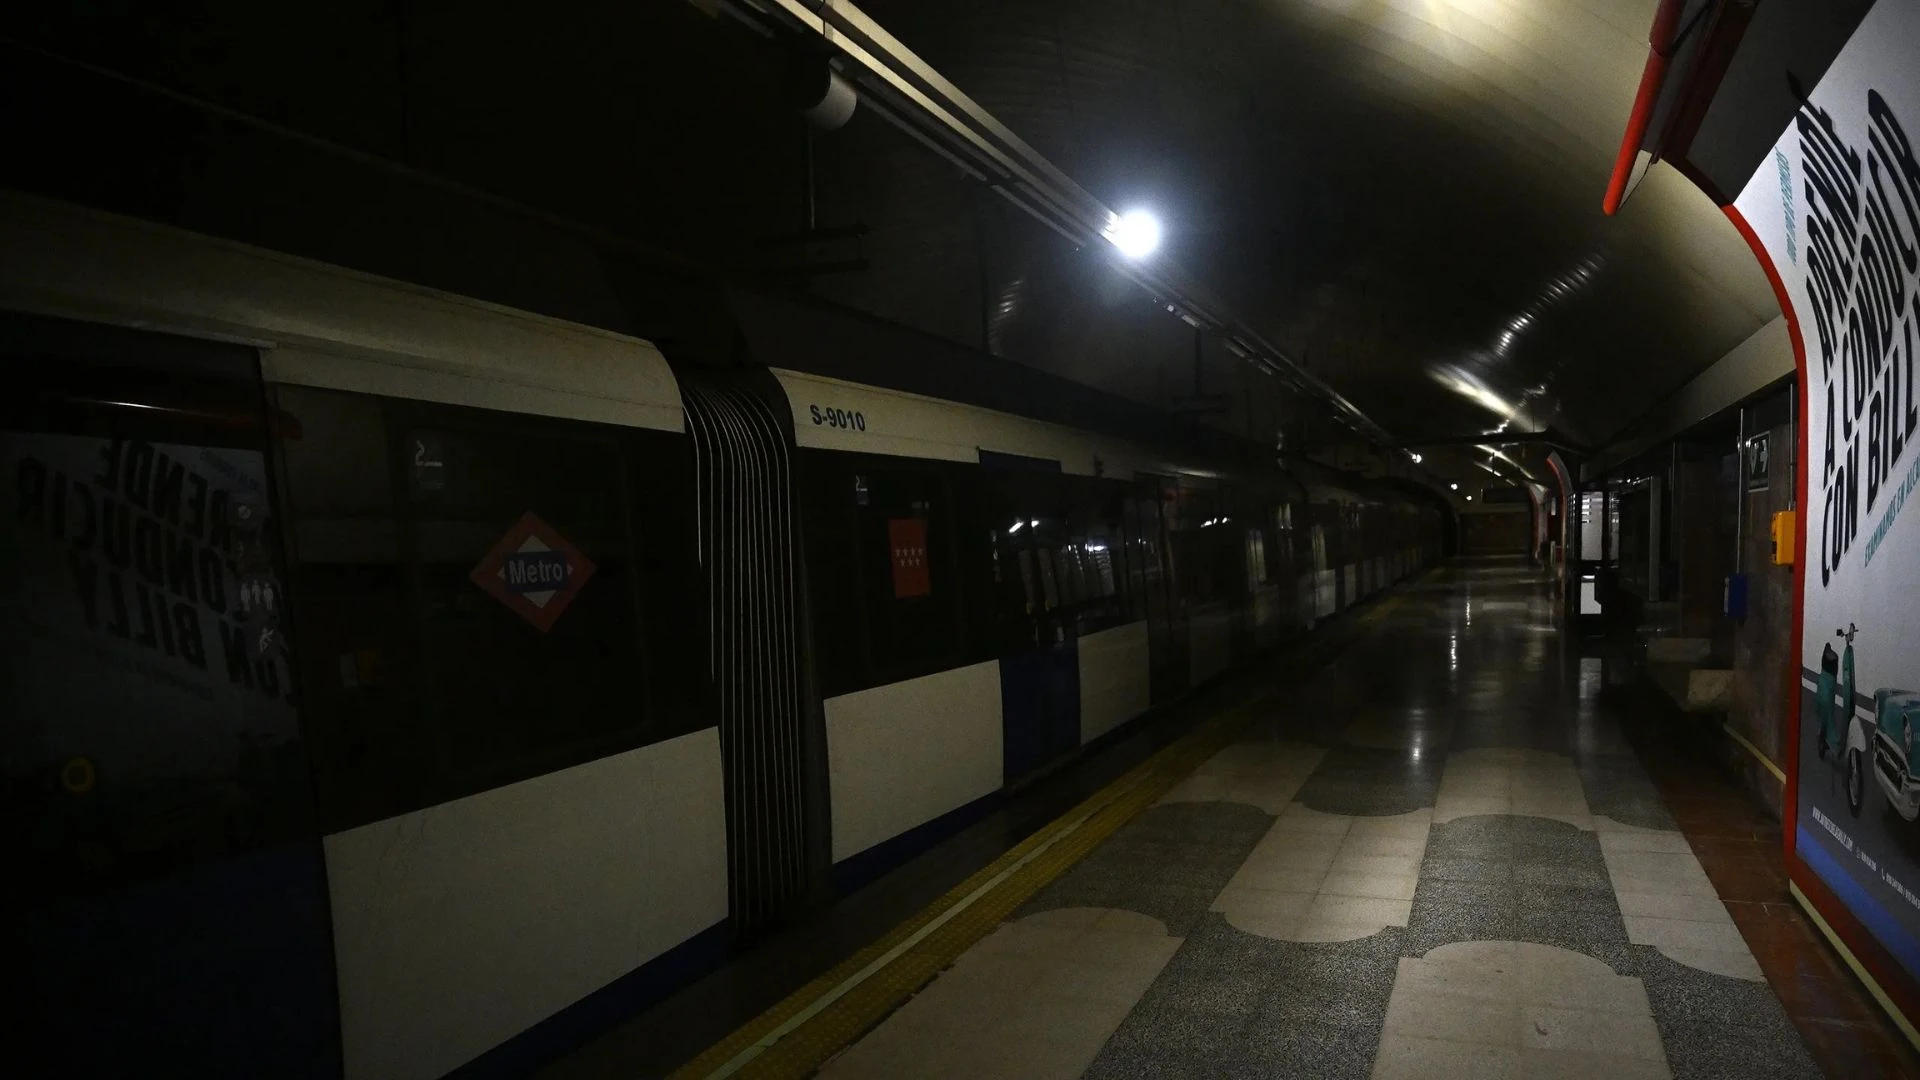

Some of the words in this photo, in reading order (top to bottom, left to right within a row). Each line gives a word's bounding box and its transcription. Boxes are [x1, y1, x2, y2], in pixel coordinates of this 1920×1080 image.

[1797, 94, 1861, 384] APRENDE
[1823, 378, 1835, 490] A
[1843, 88, 1920, 442] CONDUCIR
[810, 404, 866, 431] S-9010
[1821, 429, 1860, 588] CON
[1867, 277, 1920, 515] BILL
[508, 559, 563, 585] Metro
